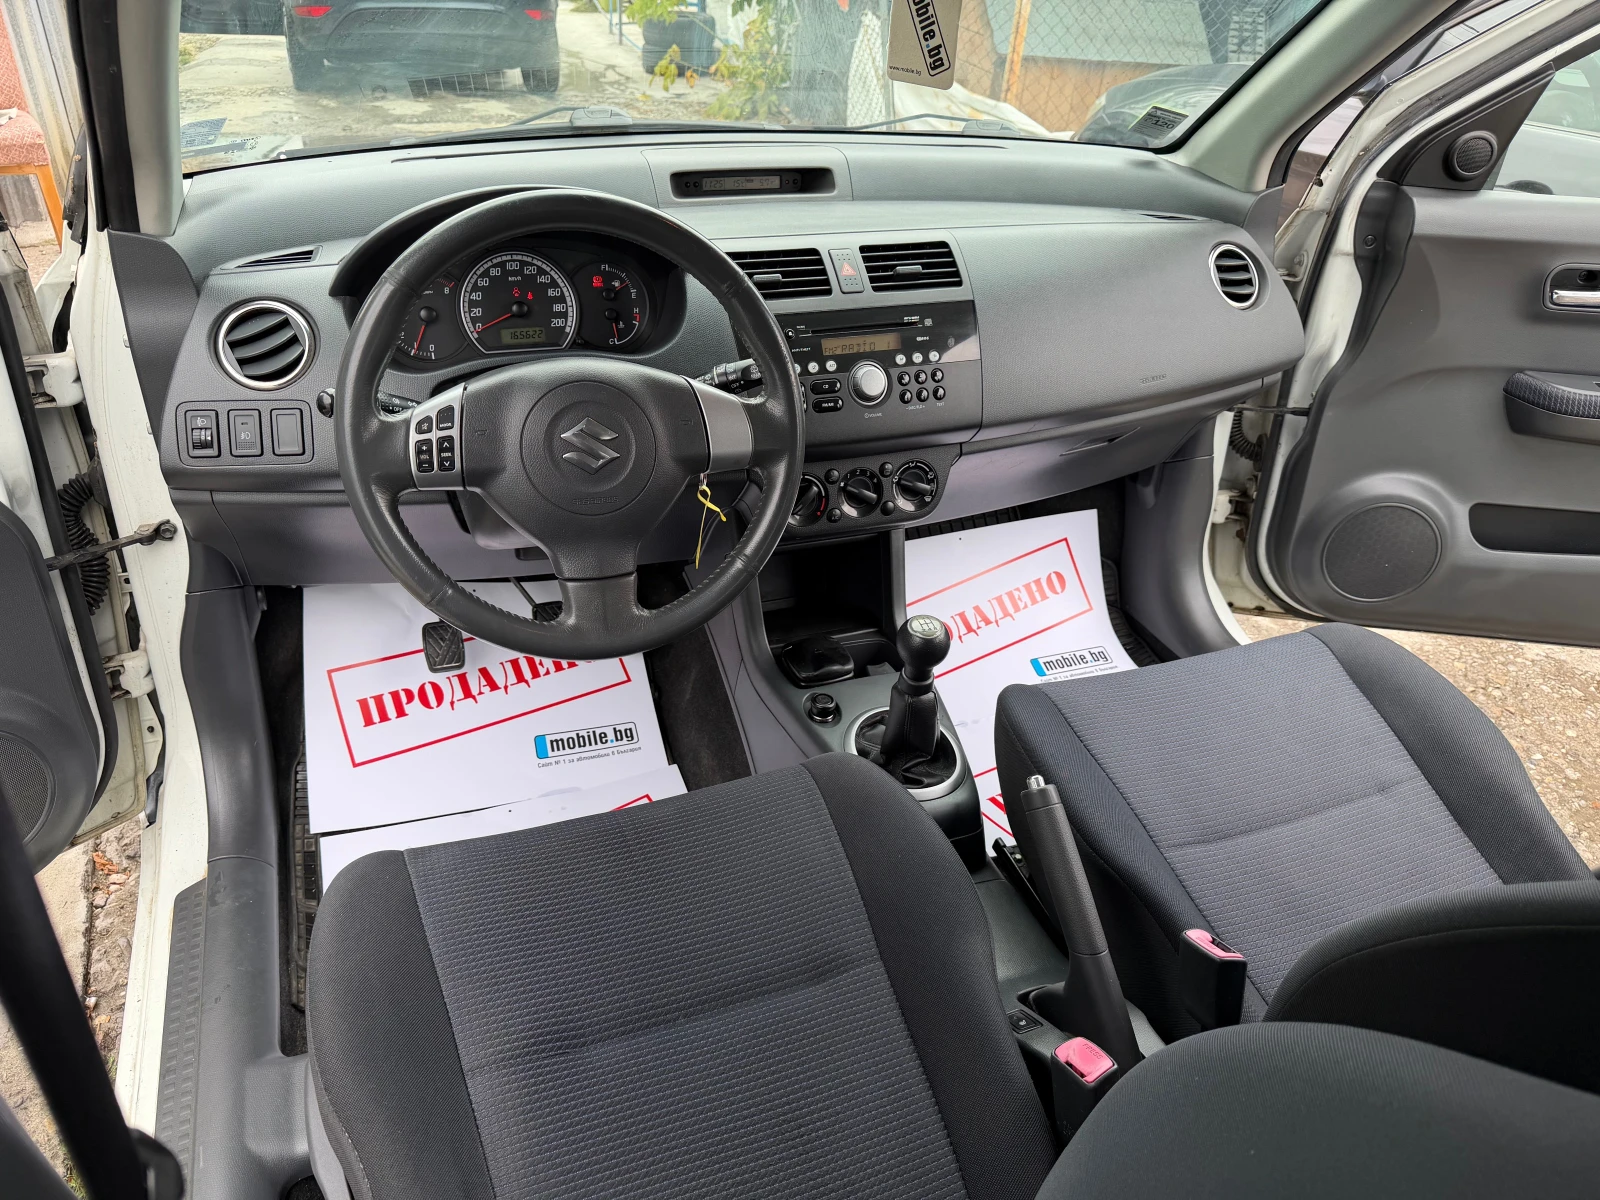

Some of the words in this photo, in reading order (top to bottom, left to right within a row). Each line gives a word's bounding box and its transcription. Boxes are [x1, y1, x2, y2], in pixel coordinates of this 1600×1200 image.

[889, 65, 921, 76] www.mobile.bg
[506, 261, 520, 270] 100
[524, 266, 537, 274] 120
[489, 267, 501, 276] 80
[477, 278, 489, 286] 60
[537, 275, 551, 283] 140
[470, 292, 482, 300] 40
[548, 288, 561, 297] 160
[470, 308, 482, 316] 20
[553, 303, 566, 312] 180
[551, 318, 566, 327] 200
[476, 323, 482, 332] 0
[510, 329, 544, 339] 165622
[943, 570, 1067, 644] ДАДЕНО
[1043, 650, 1109, 672] mobile.bg
[356, 655, 595, 728] ПРОДАДЕ
[550, 727, 635, 752] mobile.bg
[1082, 1043, 1104, 1060] PRESS
